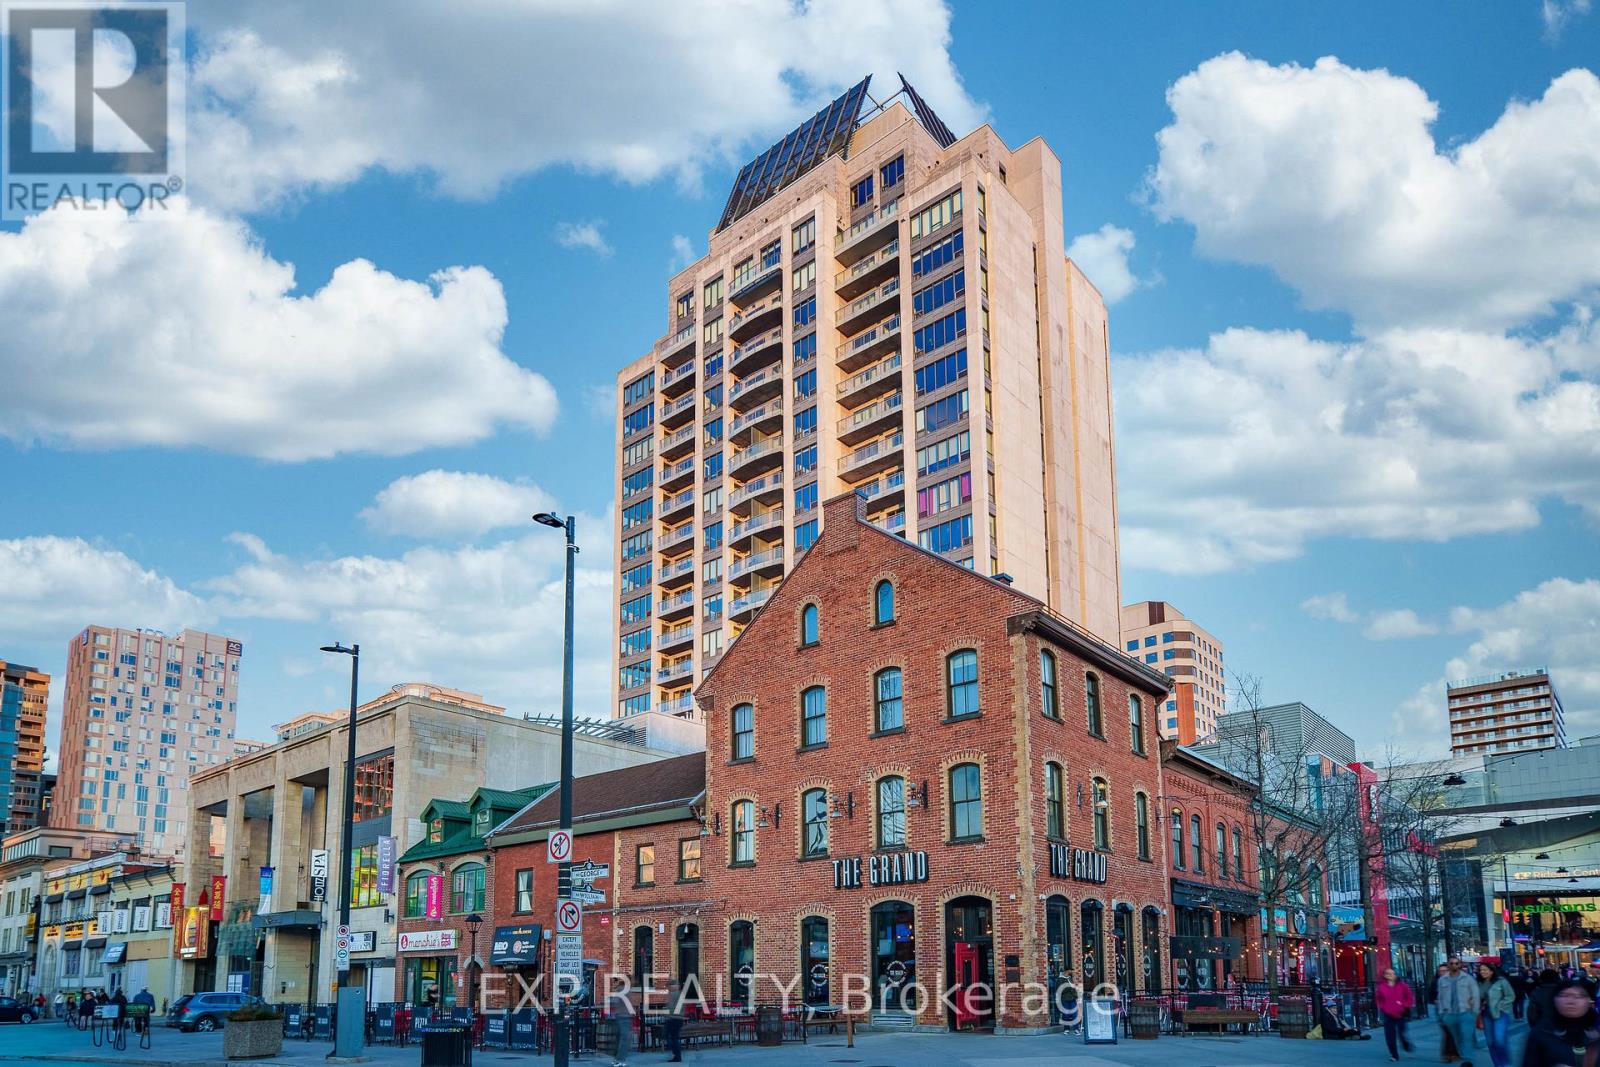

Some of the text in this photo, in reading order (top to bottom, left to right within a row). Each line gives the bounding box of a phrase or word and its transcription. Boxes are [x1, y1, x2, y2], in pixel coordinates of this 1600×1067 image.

[380, 839, 391, 887] FIORELLA
[832, 850, 927, 887] THE GRAND
[1050, 844, 1106, 882] THE GRAND
